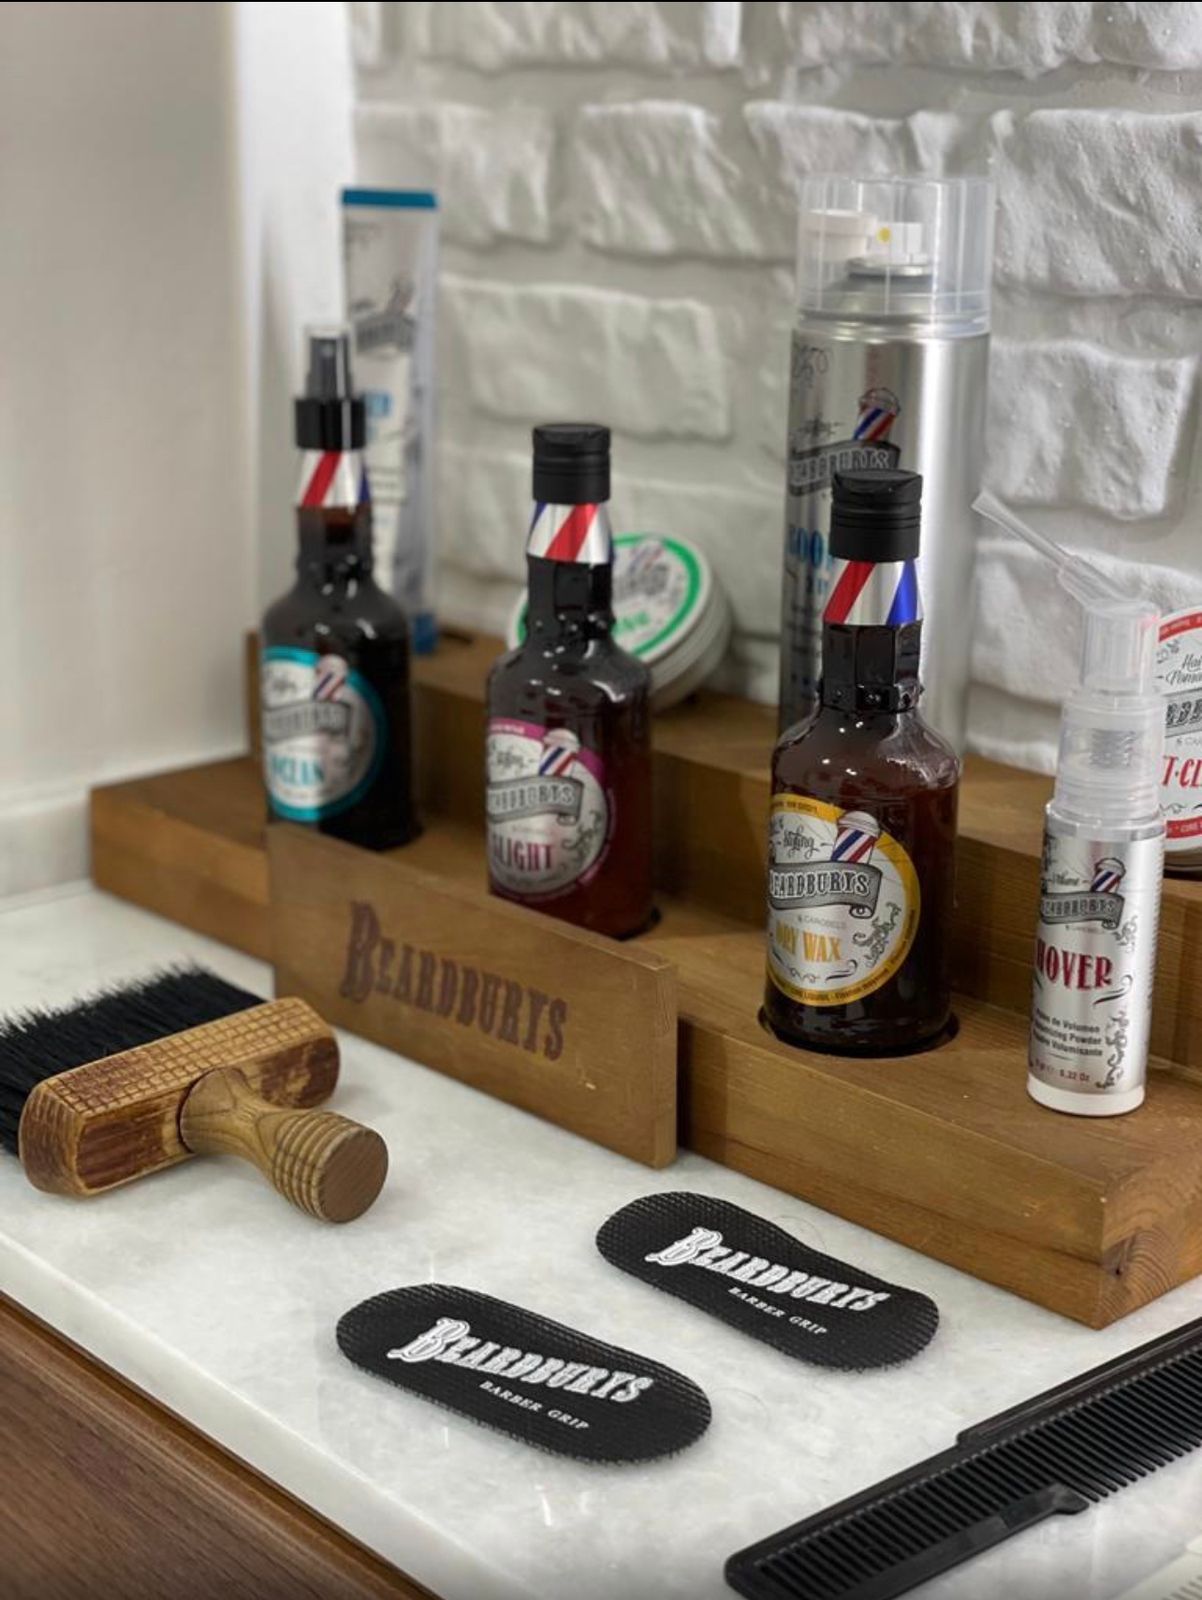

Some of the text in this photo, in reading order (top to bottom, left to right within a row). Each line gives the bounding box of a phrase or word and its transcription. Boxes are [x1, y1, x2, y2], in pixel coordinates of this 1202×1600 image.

[803, 930, 841, 962] WAX
[339, 901, 568, 1061] BEARDBURYS
[645, 1226, 891, 1311] BEARDBURYS
[728, 1287, 828, 1335] BARBER GRIP
[387, 1316, 653, 1403] BEARDBURYS
[479, 1380, 590, 1430] BARBER GRIP
